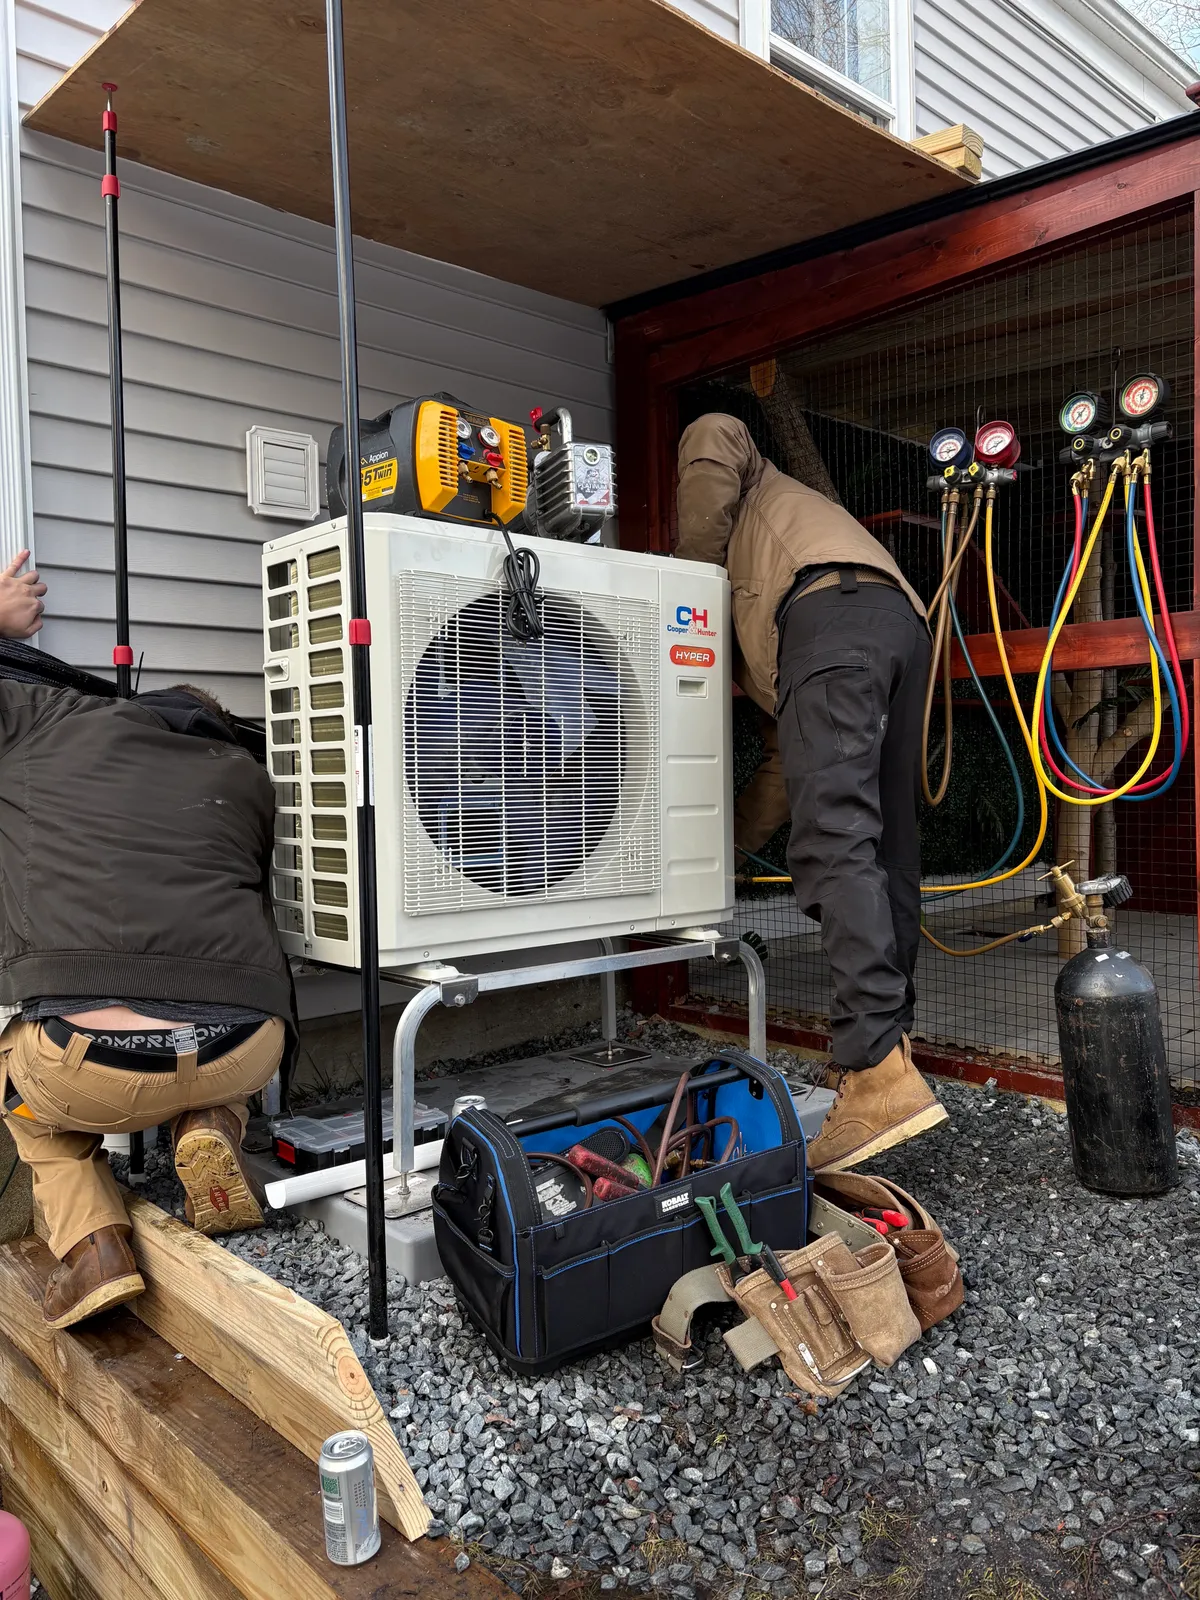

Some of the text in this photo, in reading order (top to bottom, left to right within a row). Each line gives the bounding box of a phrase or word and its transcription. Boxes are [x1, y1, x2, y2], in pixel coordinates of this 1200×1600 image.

[369, 451, 388, 463] Appion
[361, 463, 393, 486] 5Twin
[676, 606, 708, 628] CH
[666, 624, 688, 634] Cooper
[697, 628, 717, 637] Hunter
[676, 650, 710, 662] HYPER
[662, 1192, 688, 1208] KOBALT
